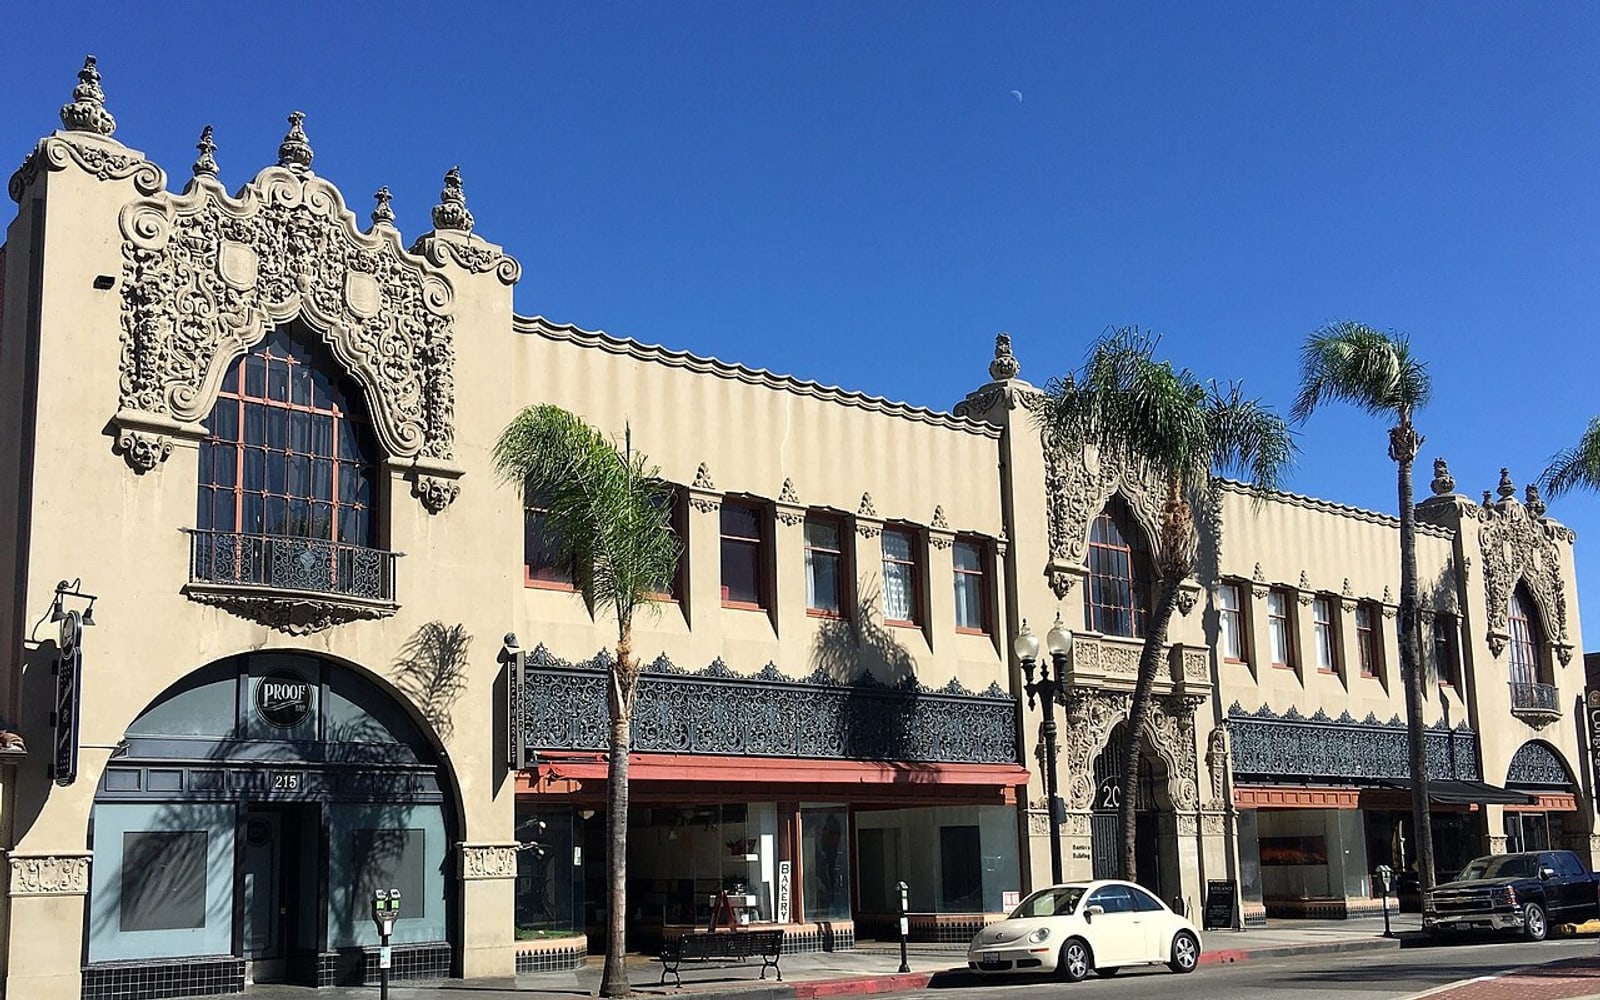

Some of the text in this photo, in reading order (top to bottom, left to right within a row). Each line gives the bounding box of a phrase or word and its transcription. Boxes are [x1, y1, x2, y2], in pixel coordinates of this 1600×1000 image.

[264, 683, 306, 707] PROOF
[275, 775, 297, 788] 215
[1103, 785, 1121, 808] 20
[781, 864, 790, 920] BAKERY
